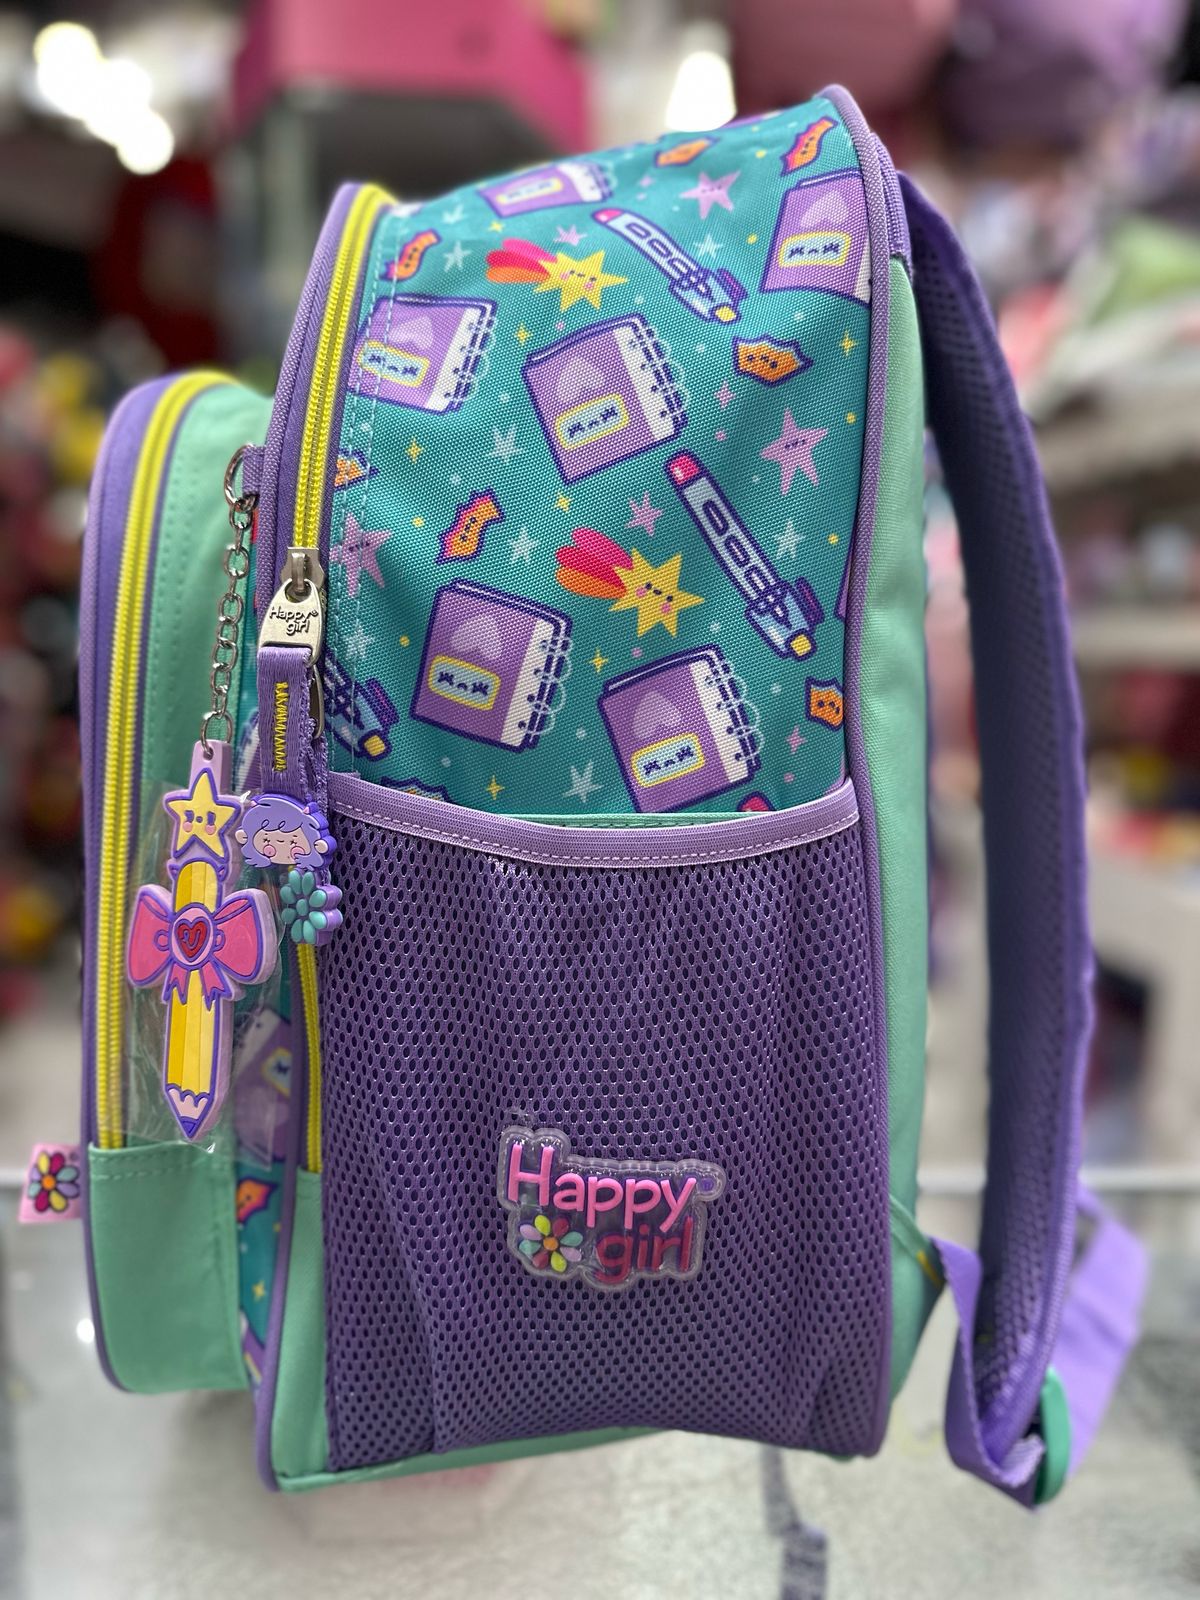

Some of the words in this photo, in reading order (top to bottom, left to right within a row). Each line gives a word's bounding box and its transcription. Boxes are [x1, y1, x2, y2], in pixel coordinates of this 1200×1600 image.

[286, 620, 310, 636] girl
[507, 1143, 697, 1233] Happy
[595, 1215, 694, 1284] girl
